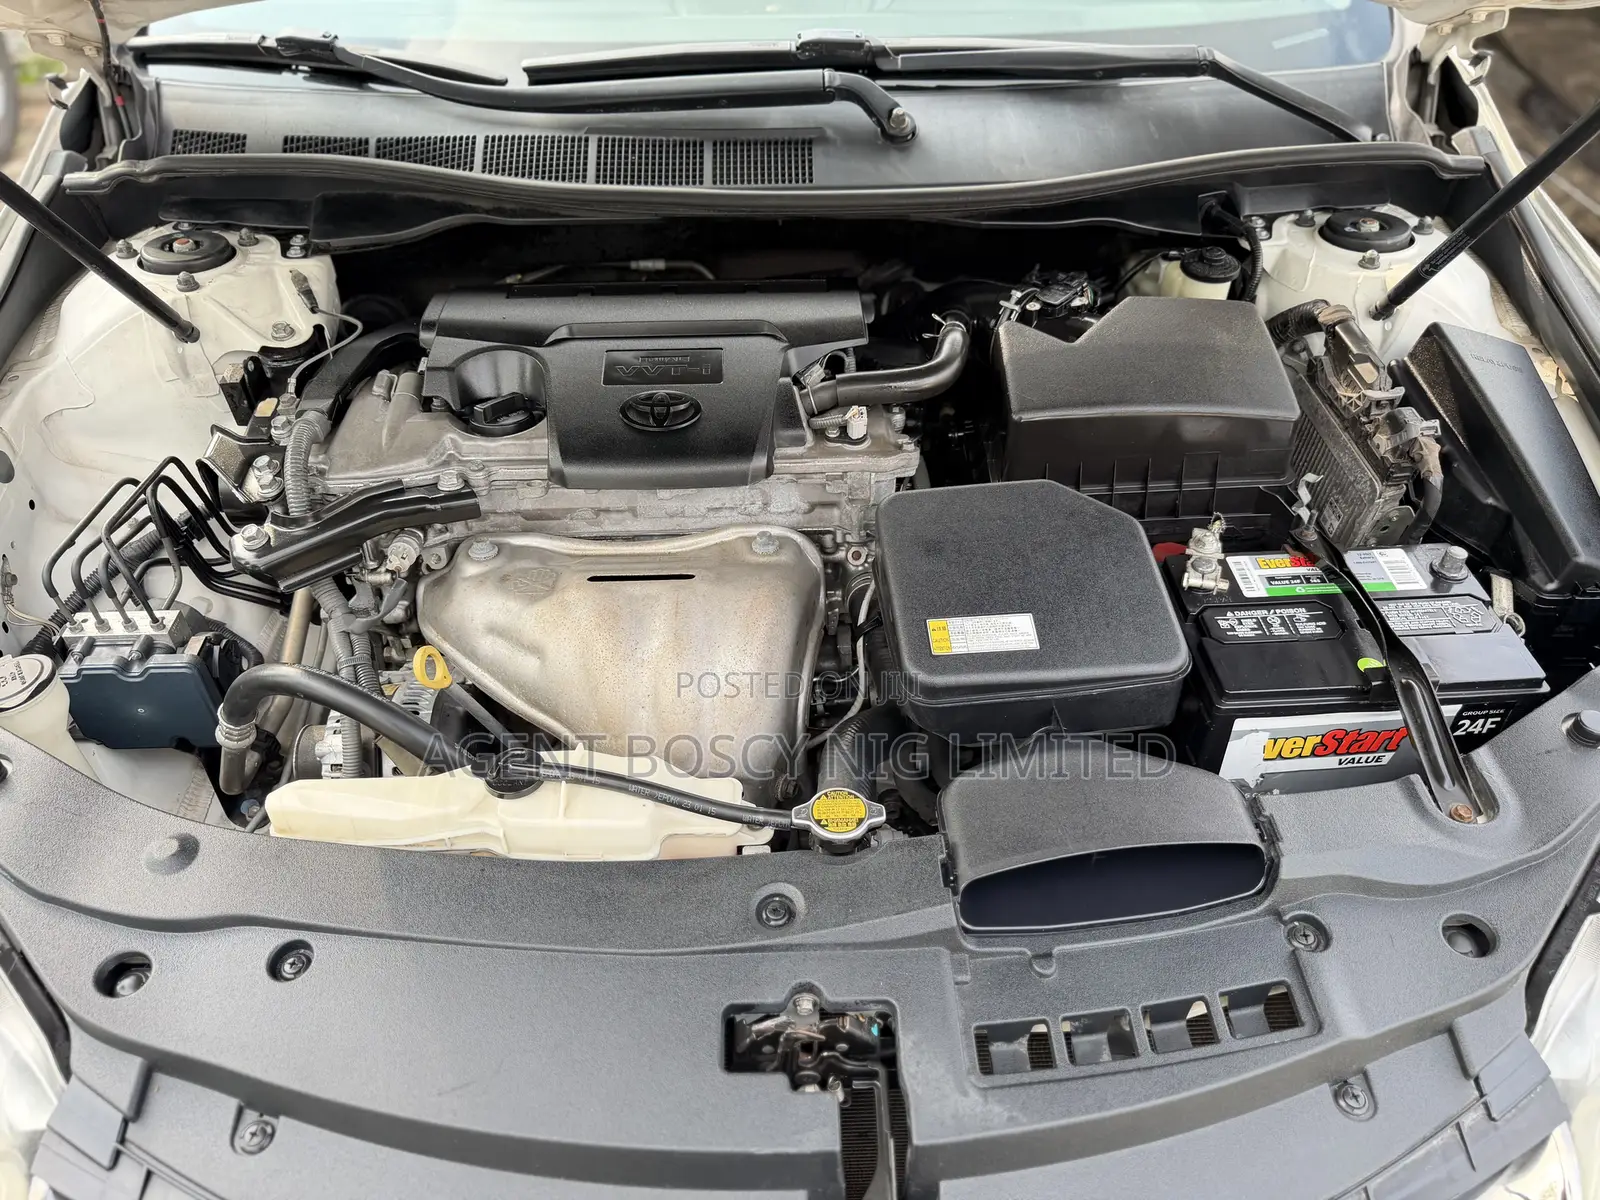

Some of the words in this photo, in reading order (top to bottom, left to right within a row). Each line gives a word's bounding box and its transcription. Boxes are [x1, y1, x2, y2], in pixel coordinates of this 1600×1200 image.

[1256, 556, 1315, 570] EverSt
[1453, 717, 1501, 736] 24F
[1263, 727, 1408, 761] verStart
[1338, 754, 1386, 766] VALUE
[628, 783, 651, 798] WATER
[681, 800, 692, 810] 23
[706, 806, 717, 816] 15
